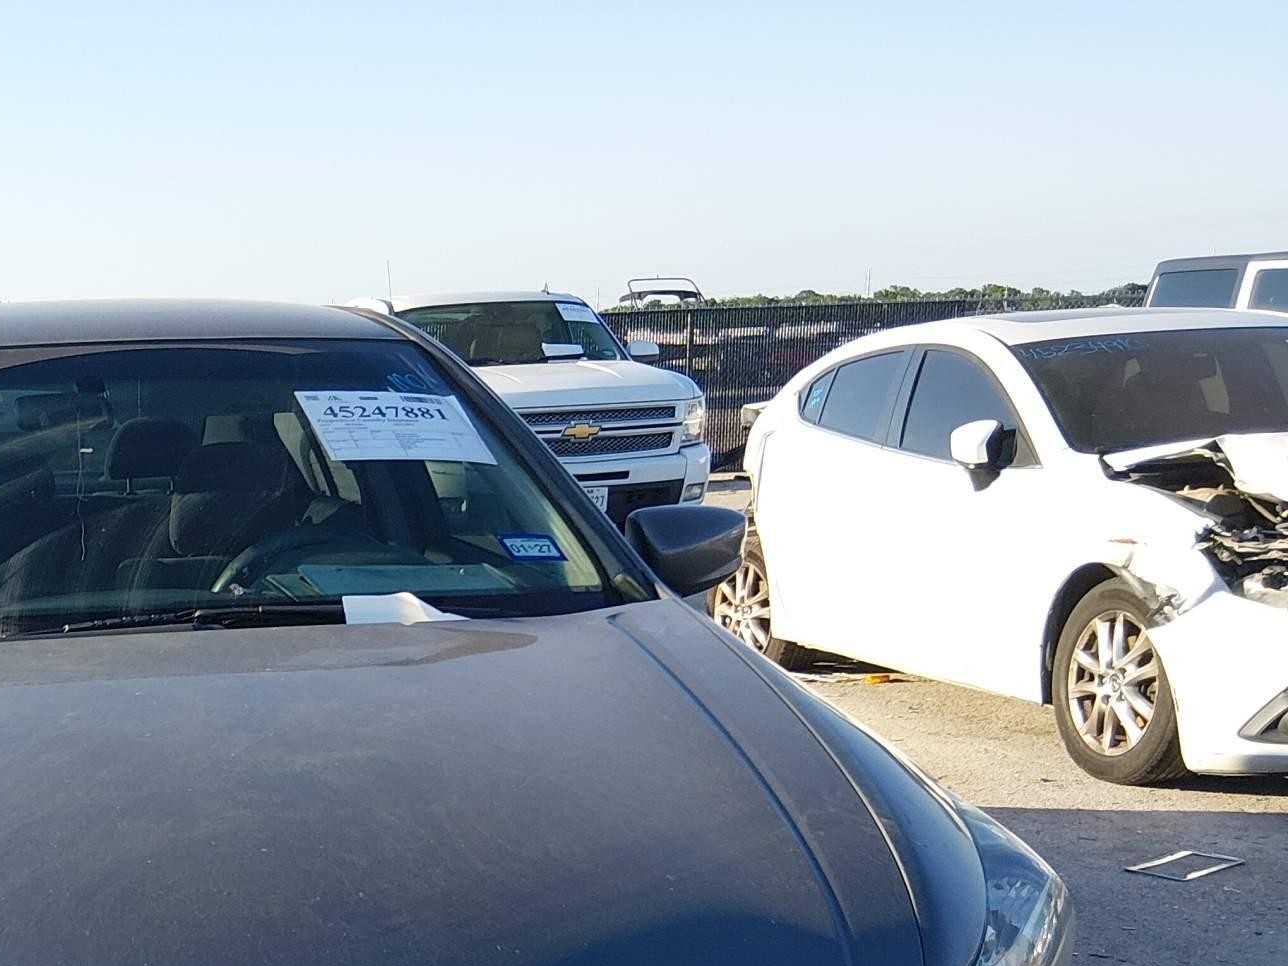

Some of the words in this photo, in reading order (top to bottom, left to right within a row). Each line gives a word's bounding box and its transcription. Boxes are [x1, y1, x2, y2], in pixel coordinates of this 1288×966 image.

[323, 405, 448, 420] 45247881
[510, 544, 528, 553] 01
[534, 544, 551, 553] 27
